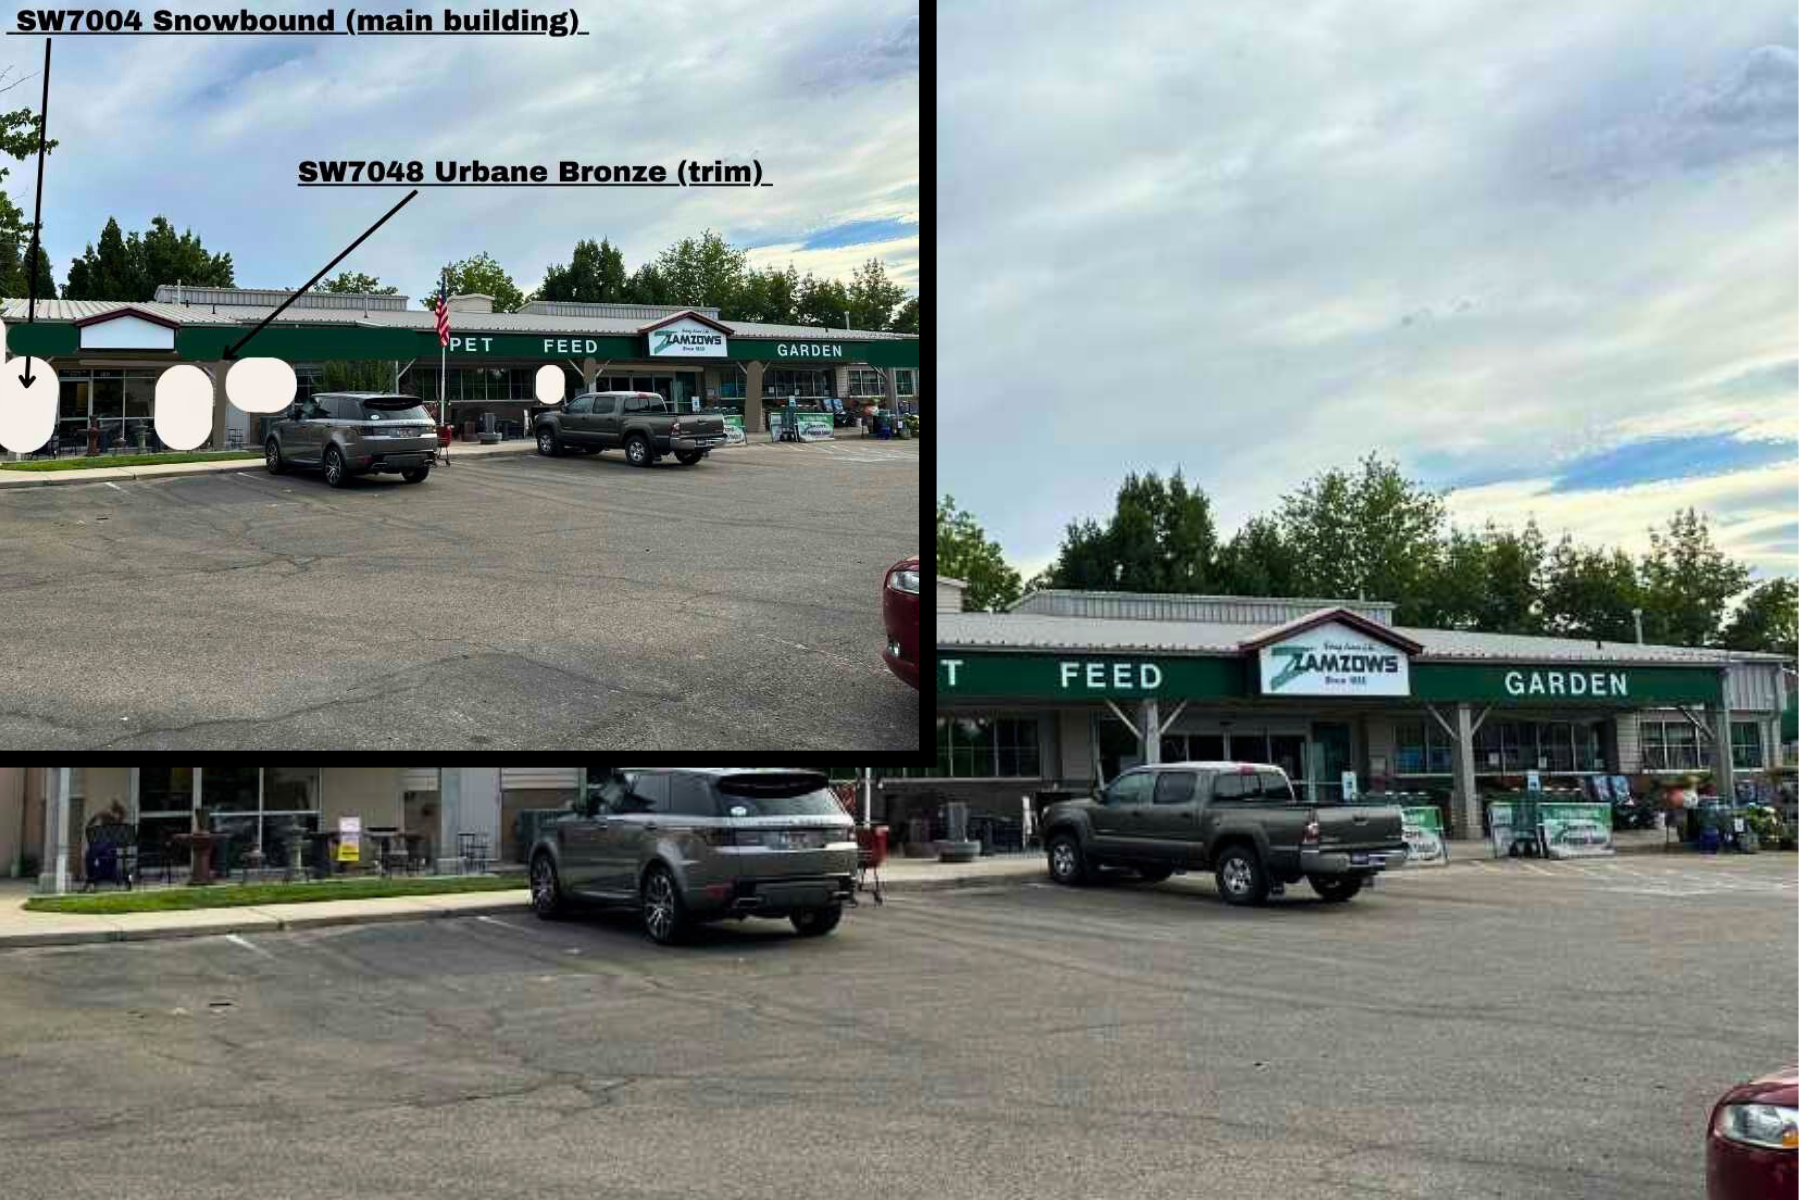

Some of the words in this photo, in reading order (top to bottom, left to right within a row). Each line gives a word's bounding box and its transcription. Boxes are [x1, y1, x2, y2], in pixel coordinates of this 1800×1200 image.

[449, 337, 493, 352] PET
[544, 339, 598, 354] FEED
[777, 343, 842, 357] GARDEN
[1060, 662, 1163, 689] FEED
[1504, 672, 1628, 696] GARDEN
